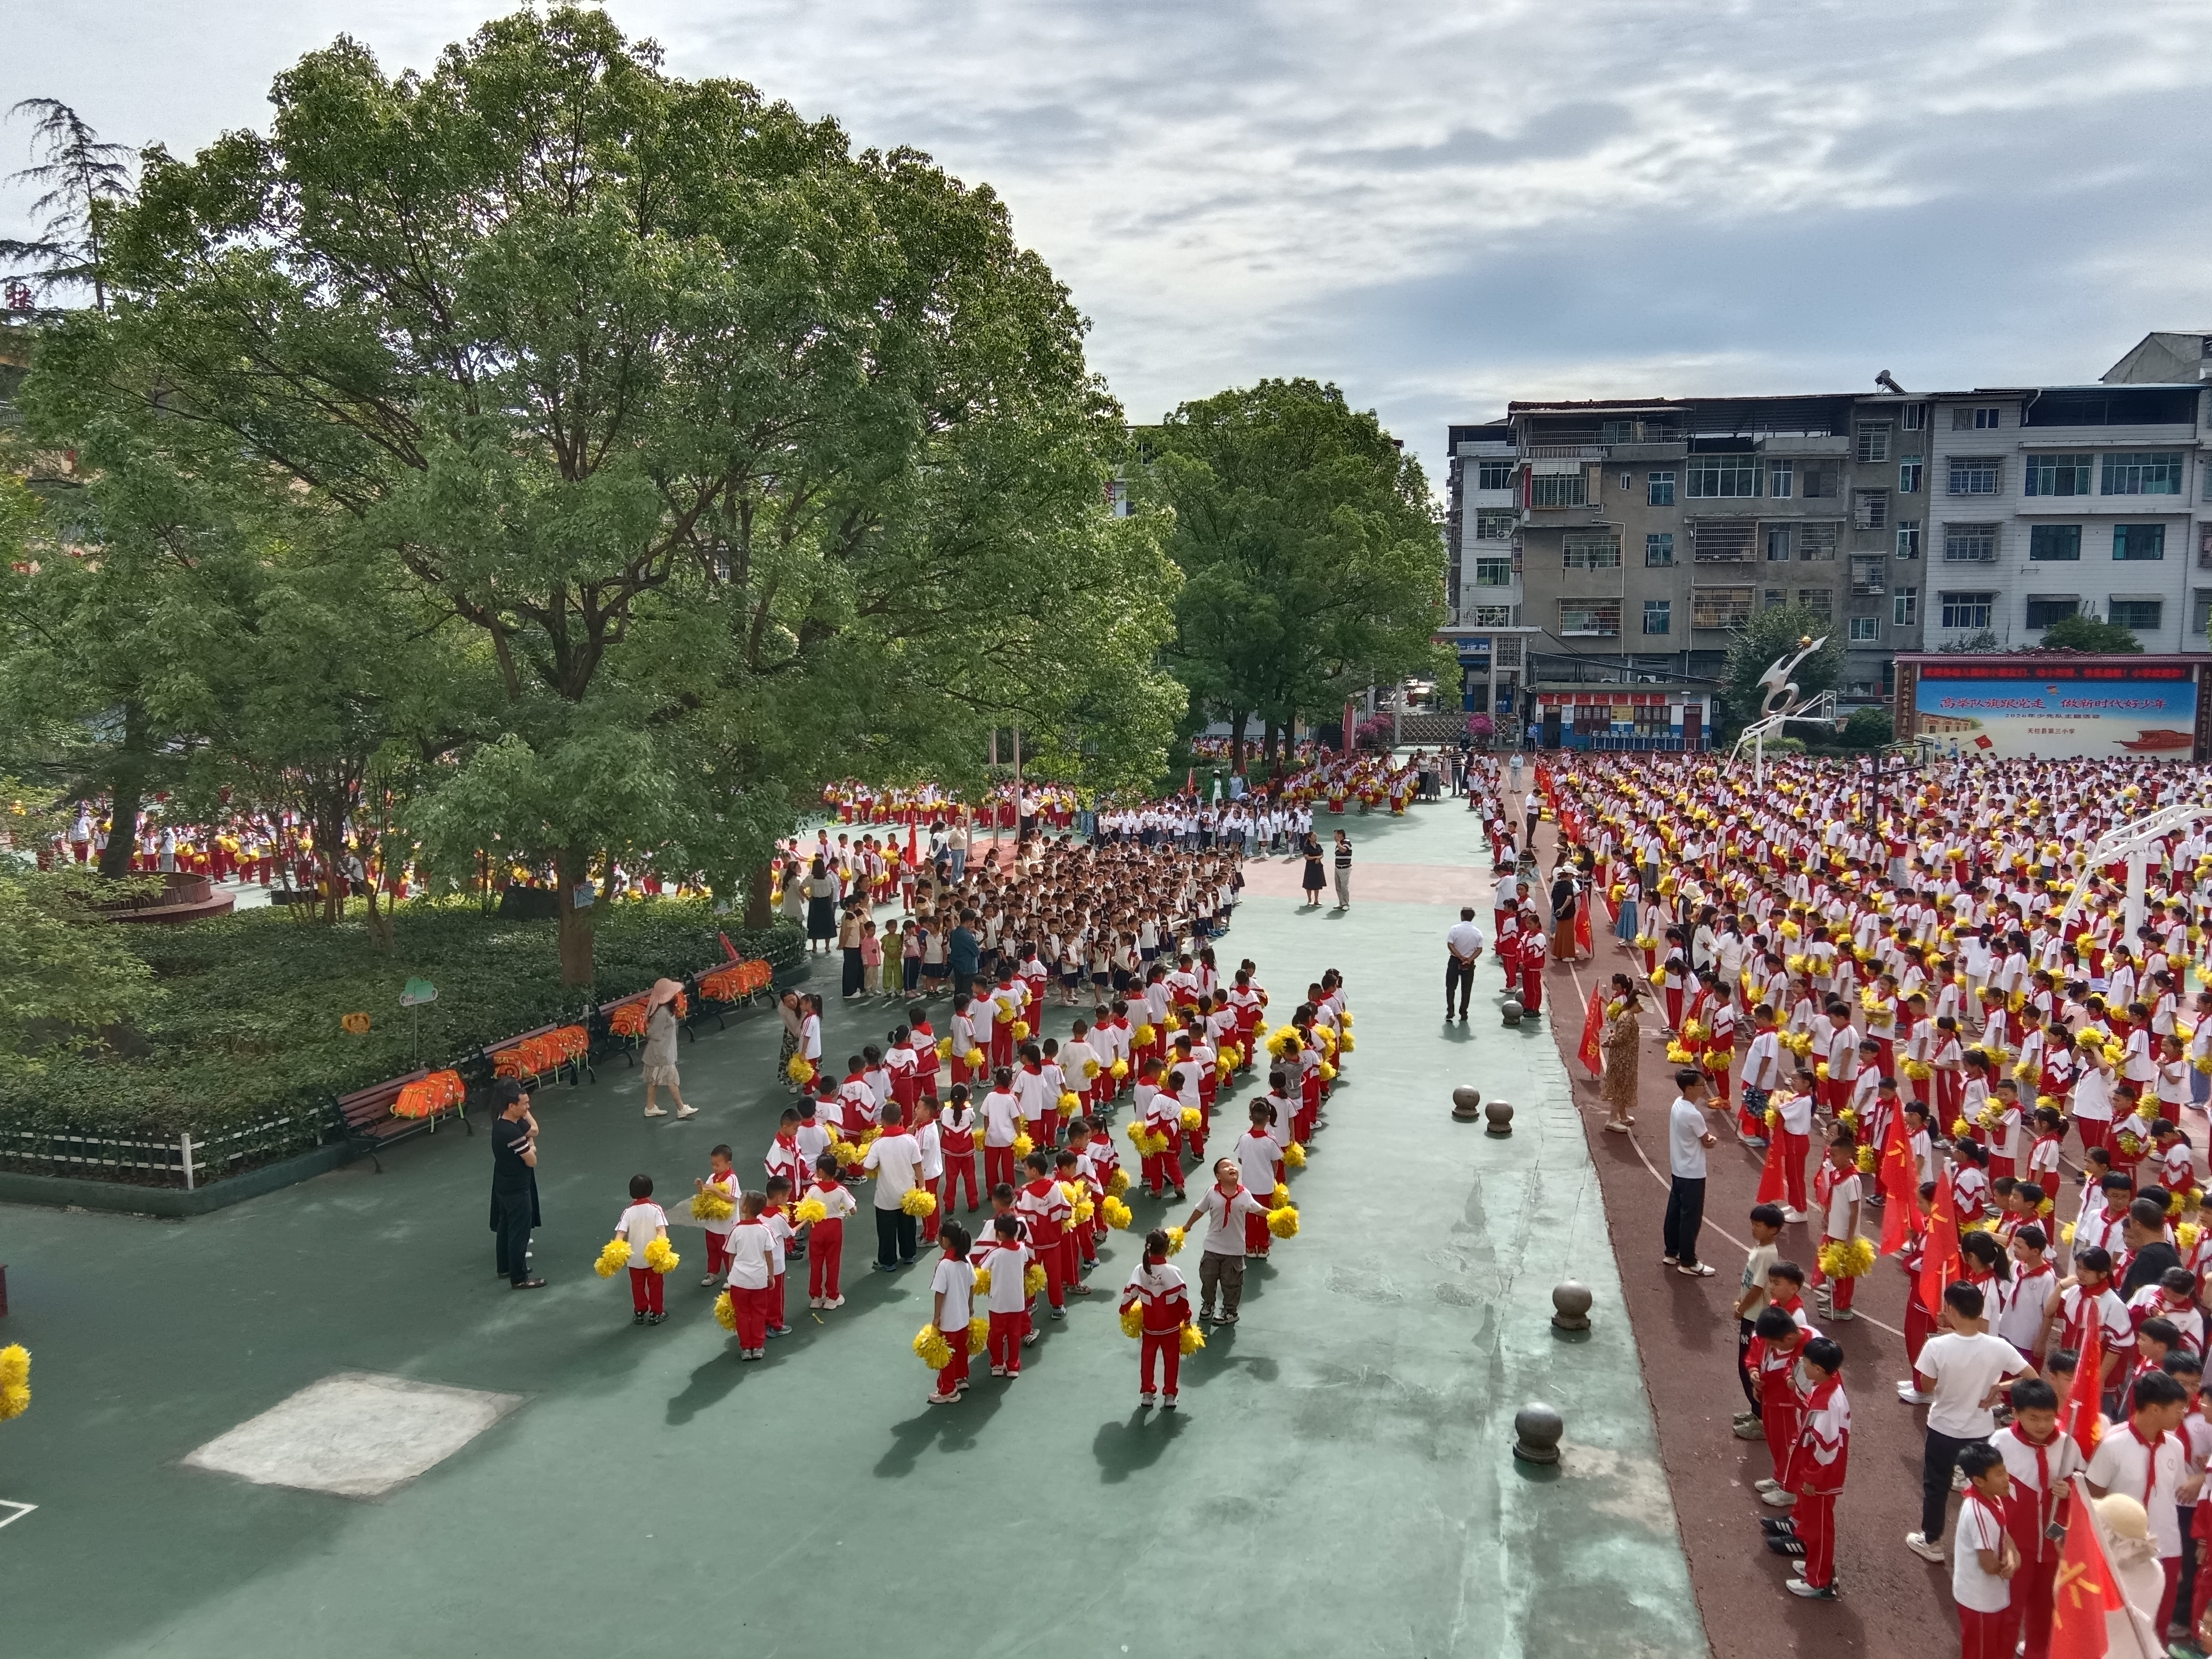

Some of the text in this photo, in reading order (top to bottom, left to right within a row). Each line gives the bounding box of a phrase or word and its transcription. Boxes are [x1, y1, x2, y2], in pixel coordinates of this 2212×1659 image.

[1941, 698, 2167, 709] 高举队旗跟党走 做新时代好少年
